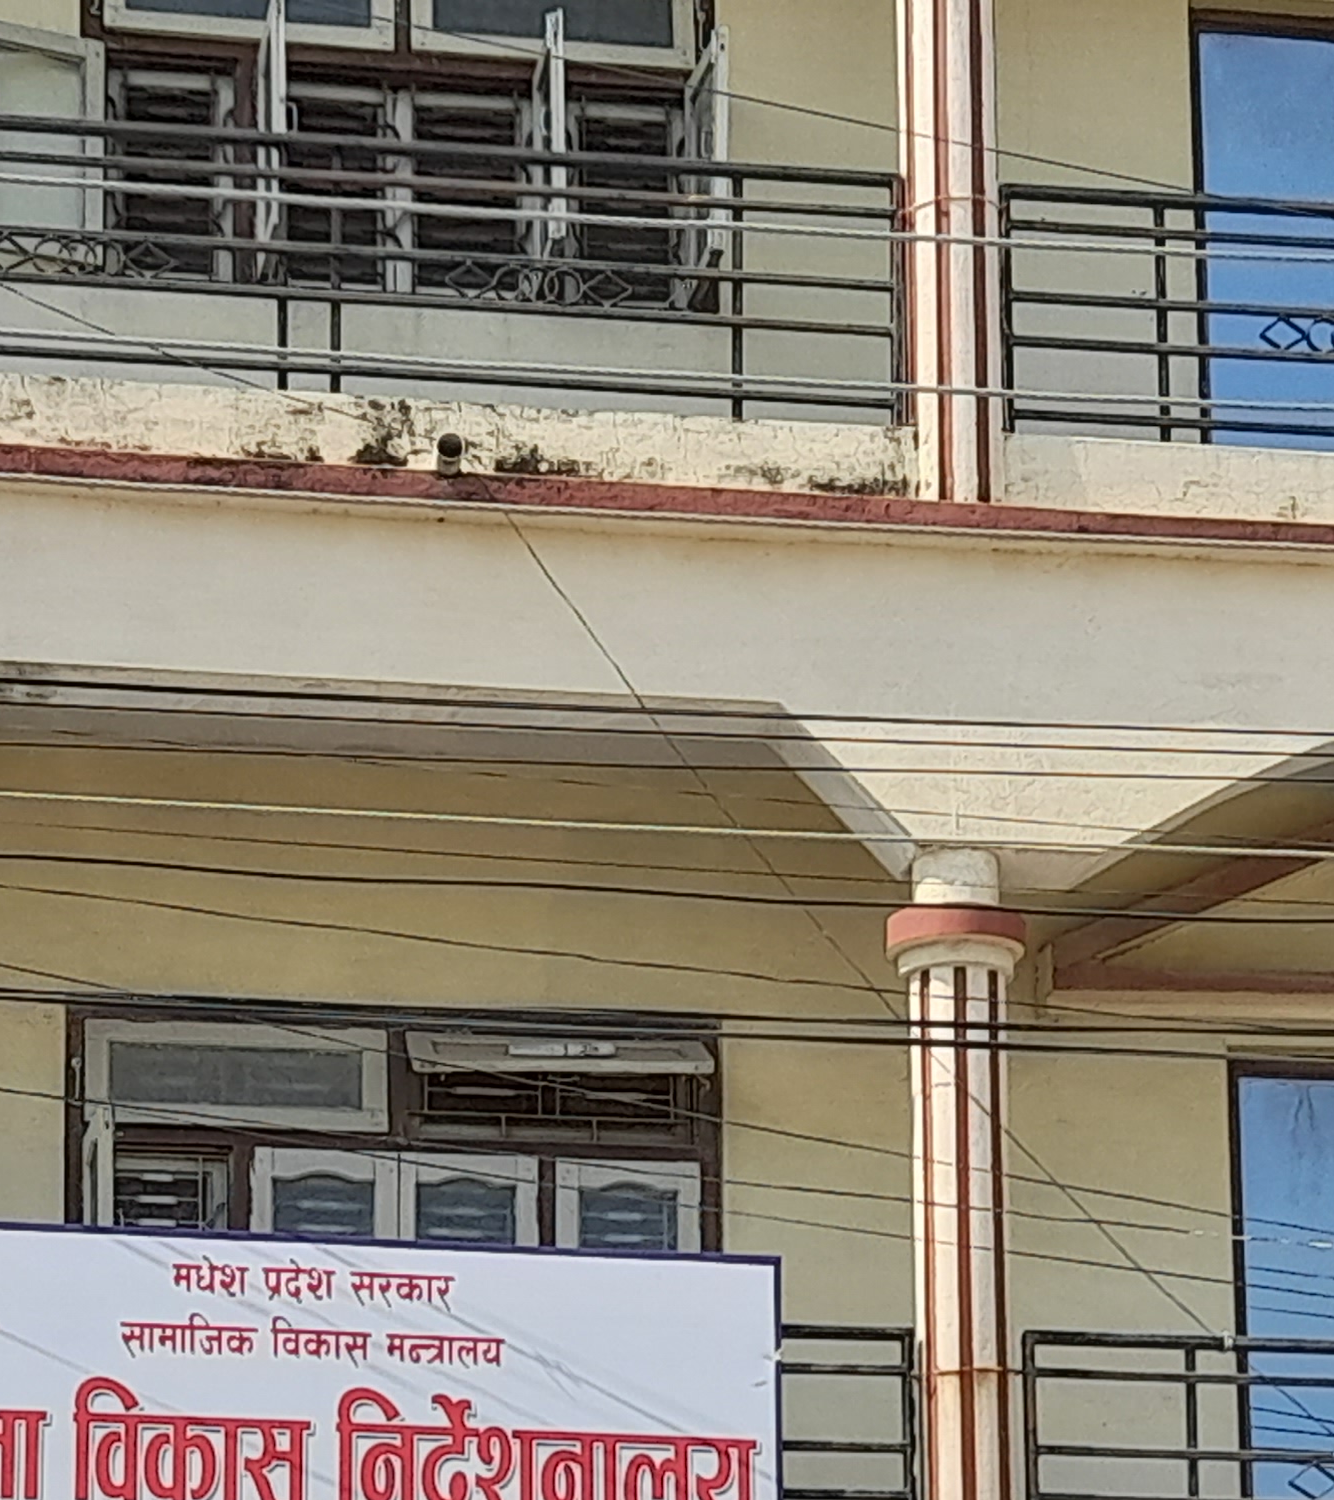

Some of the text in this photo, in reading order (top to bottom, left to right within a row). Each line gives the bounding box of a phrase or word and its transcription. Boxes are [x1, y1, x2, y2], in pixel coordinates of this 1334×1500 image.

[172, 1255, 455, 1312] मधेश प्रदेश सरकार
[120, 1313, 505, 1368] सामाजिक विकास मन्त्रालय
